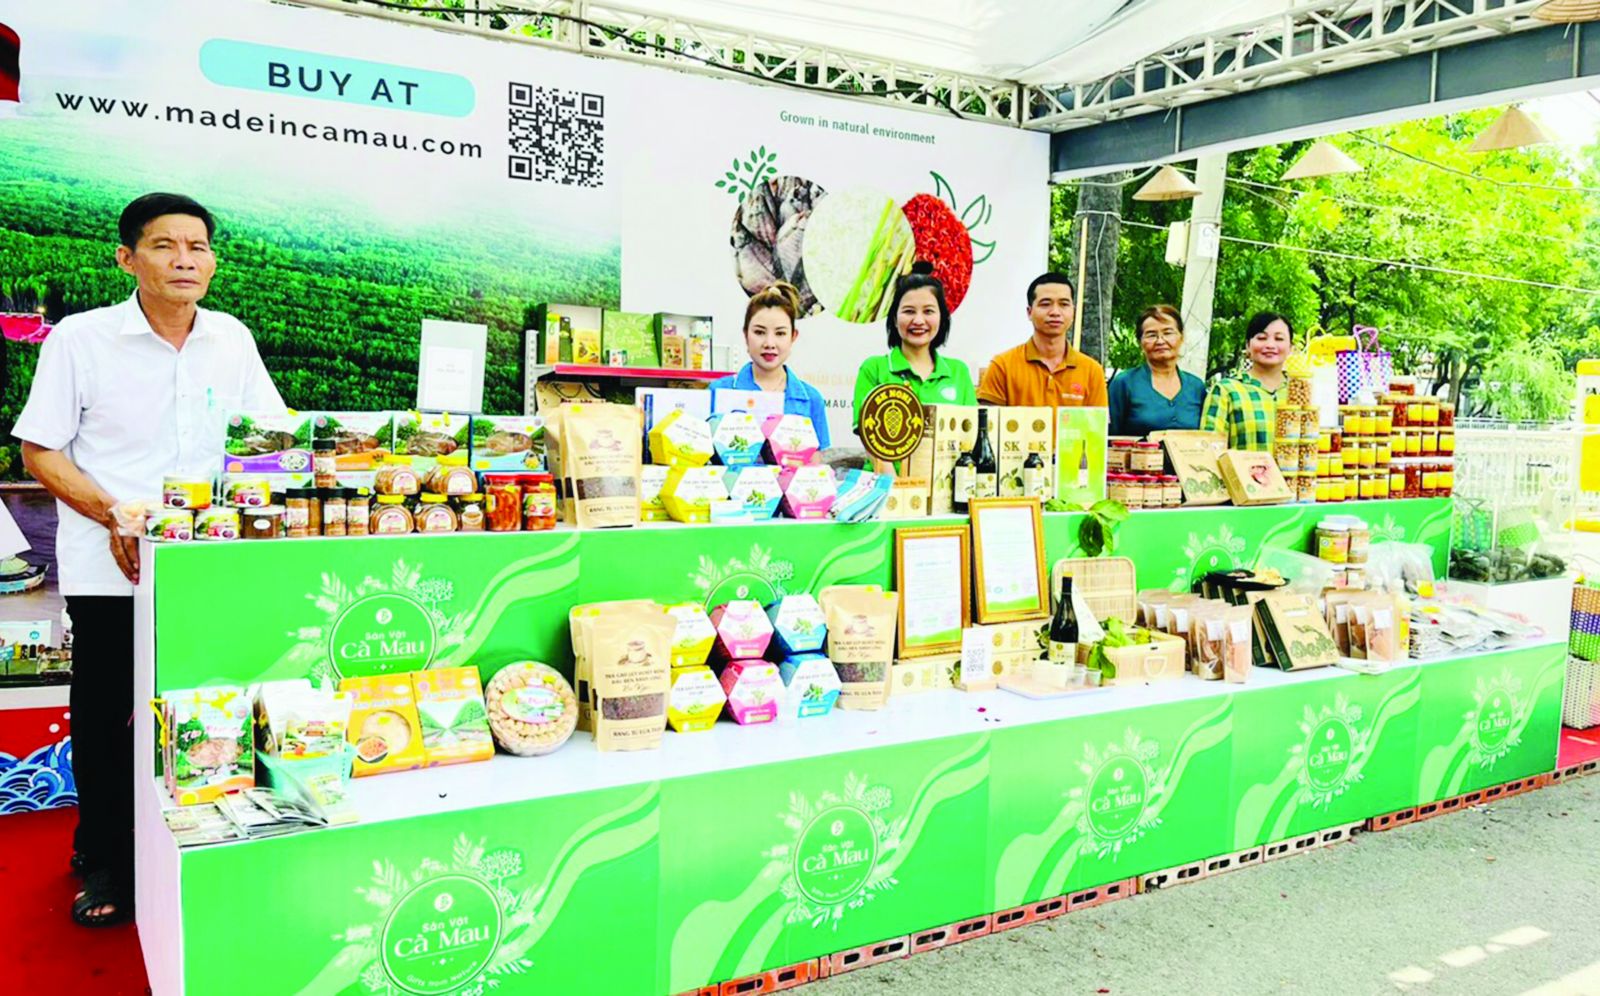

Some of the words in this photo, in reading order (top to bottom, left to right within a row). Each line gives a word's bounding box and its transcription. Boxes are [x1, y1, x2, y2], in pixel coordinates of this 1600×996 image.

[268, 62, 352, 97] BUY
[371, 78, 418, 106] AT
[56, 92, 483, 159] www.madeincamau.com
[780, 110, 815, 126] Grown
[818, 116, 829, 128] in
[832, 120, 869, 135] natural
[872, 127, 936, 145] environment
[1003, 441, 1020, 452] SK
[341, 640, 371, 659] Cà
[380, 639, 425, 657] Mau
[1115, 791, 1141, 808] Mau
[803, 853, 826, 873] Cà
[833, 848, 869, 867] Mau
[394, 933, 429, 958] Cà
[439, 924, 490, 949] Mau
